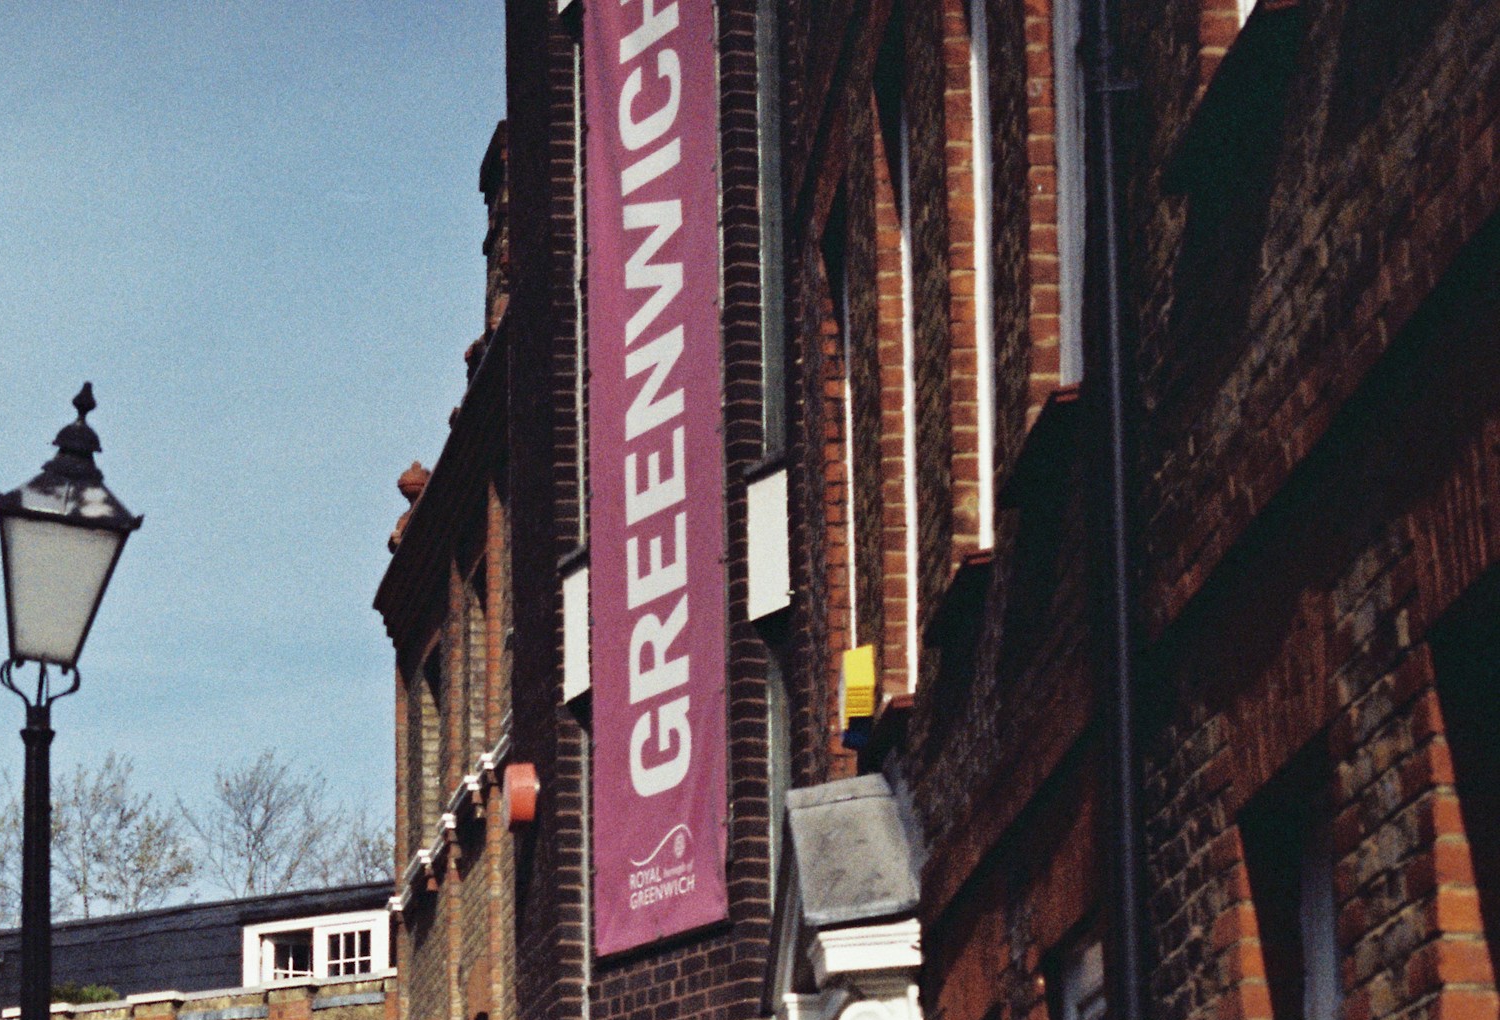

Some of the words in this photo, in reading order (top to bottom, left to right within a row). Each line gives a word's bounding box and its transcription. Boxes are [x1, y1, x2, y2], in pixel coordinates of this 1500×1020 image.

[618, 0, 692, 798] GREENWICH
[630, 866, 662, 890] ROYAL
[630, 874, 696, 910] GREENWICH
